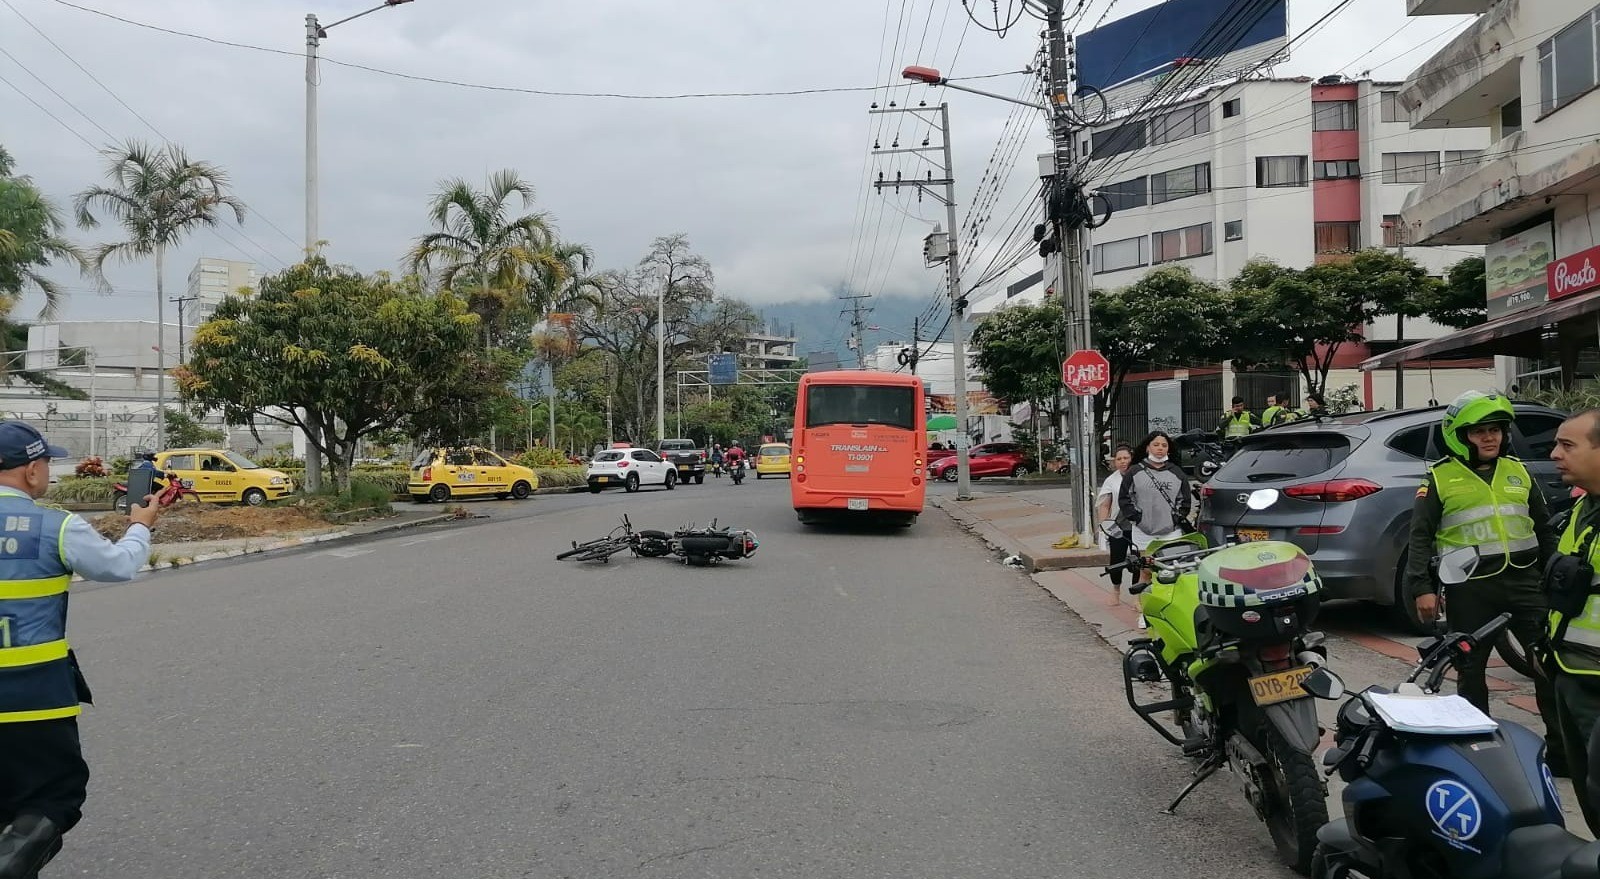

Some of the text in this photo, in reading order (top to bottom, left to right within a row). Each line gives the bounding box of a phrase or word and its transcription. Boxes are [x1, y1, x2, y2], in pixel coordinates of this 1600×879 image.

[1555, 258, 1596, 293] Presto
[1067, 363, 1104, 381] PARE
[831, 444, 877, 452] TRANSLAIN
[5, 516, 30, 531] DE
